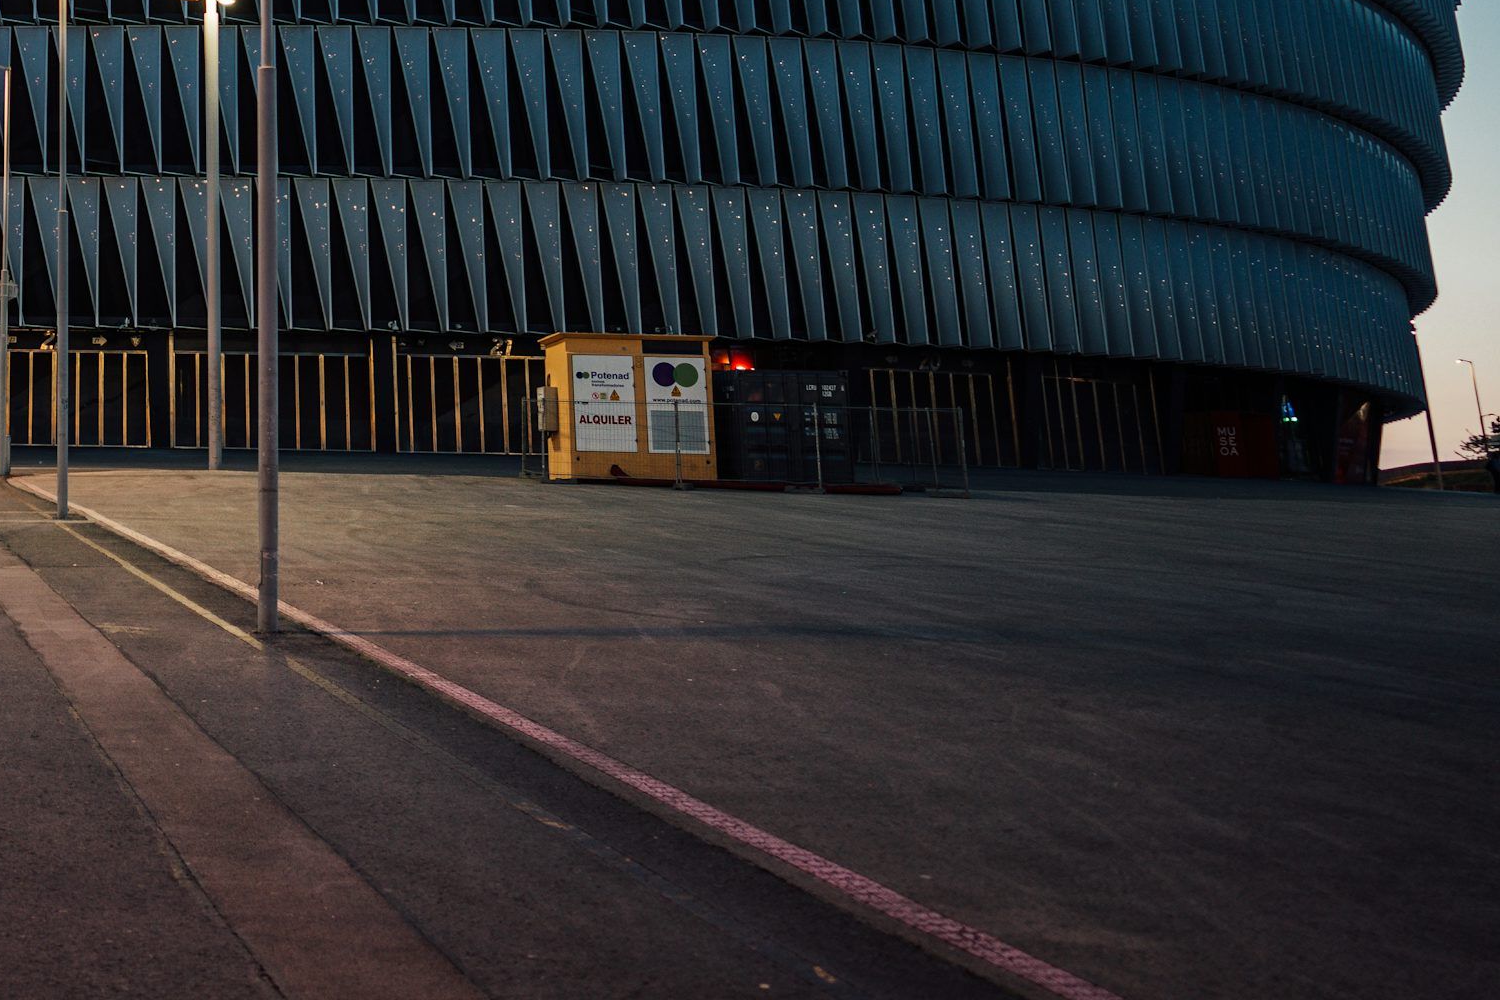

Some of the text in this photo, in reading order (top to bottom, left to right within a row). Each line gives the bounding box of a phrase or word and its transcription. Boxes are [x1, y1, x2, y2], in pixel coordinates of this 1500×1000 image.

[489, 337, 513, 356] 21
[590, 371, 629, 380] Potenad
[579, 414, 632, 425] ALQUILER
[1216, 426, 1237, 437] MU
[1219, 436, 1237, 447] SE
[1219, 446, 1240, 457] OA
